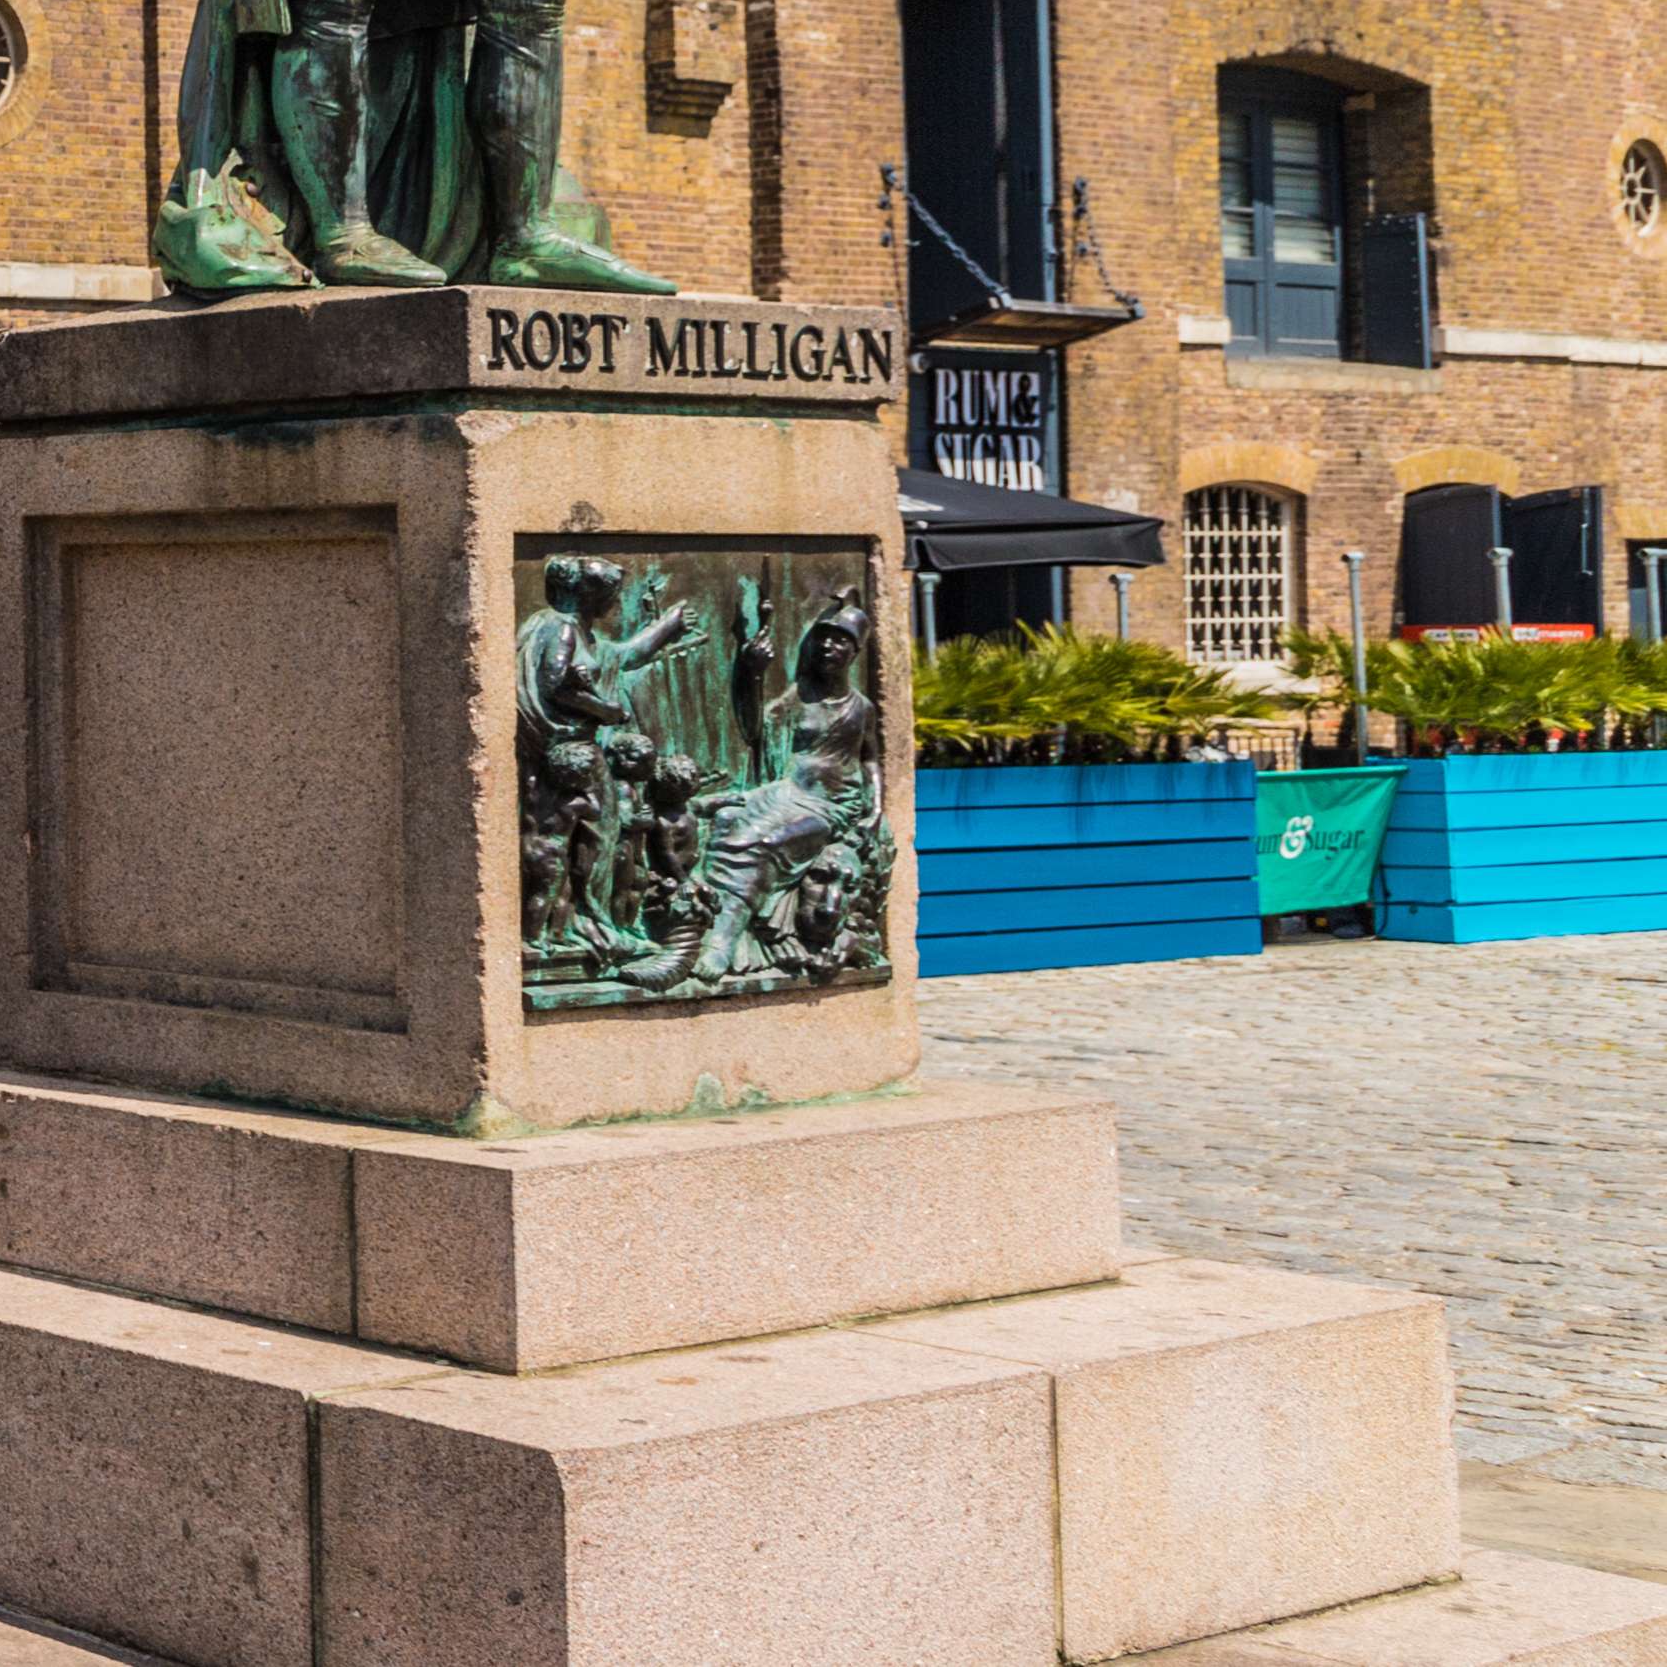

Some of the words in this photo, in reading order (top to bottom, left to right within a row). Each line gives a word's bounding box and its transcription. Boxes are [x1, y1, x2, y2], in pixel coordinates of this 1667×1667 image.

[486, 307, 628, 372] ROBT
[644, 316, 894, 383] MILLIGAN
[934, 432, 1044, 491] SUGAR
